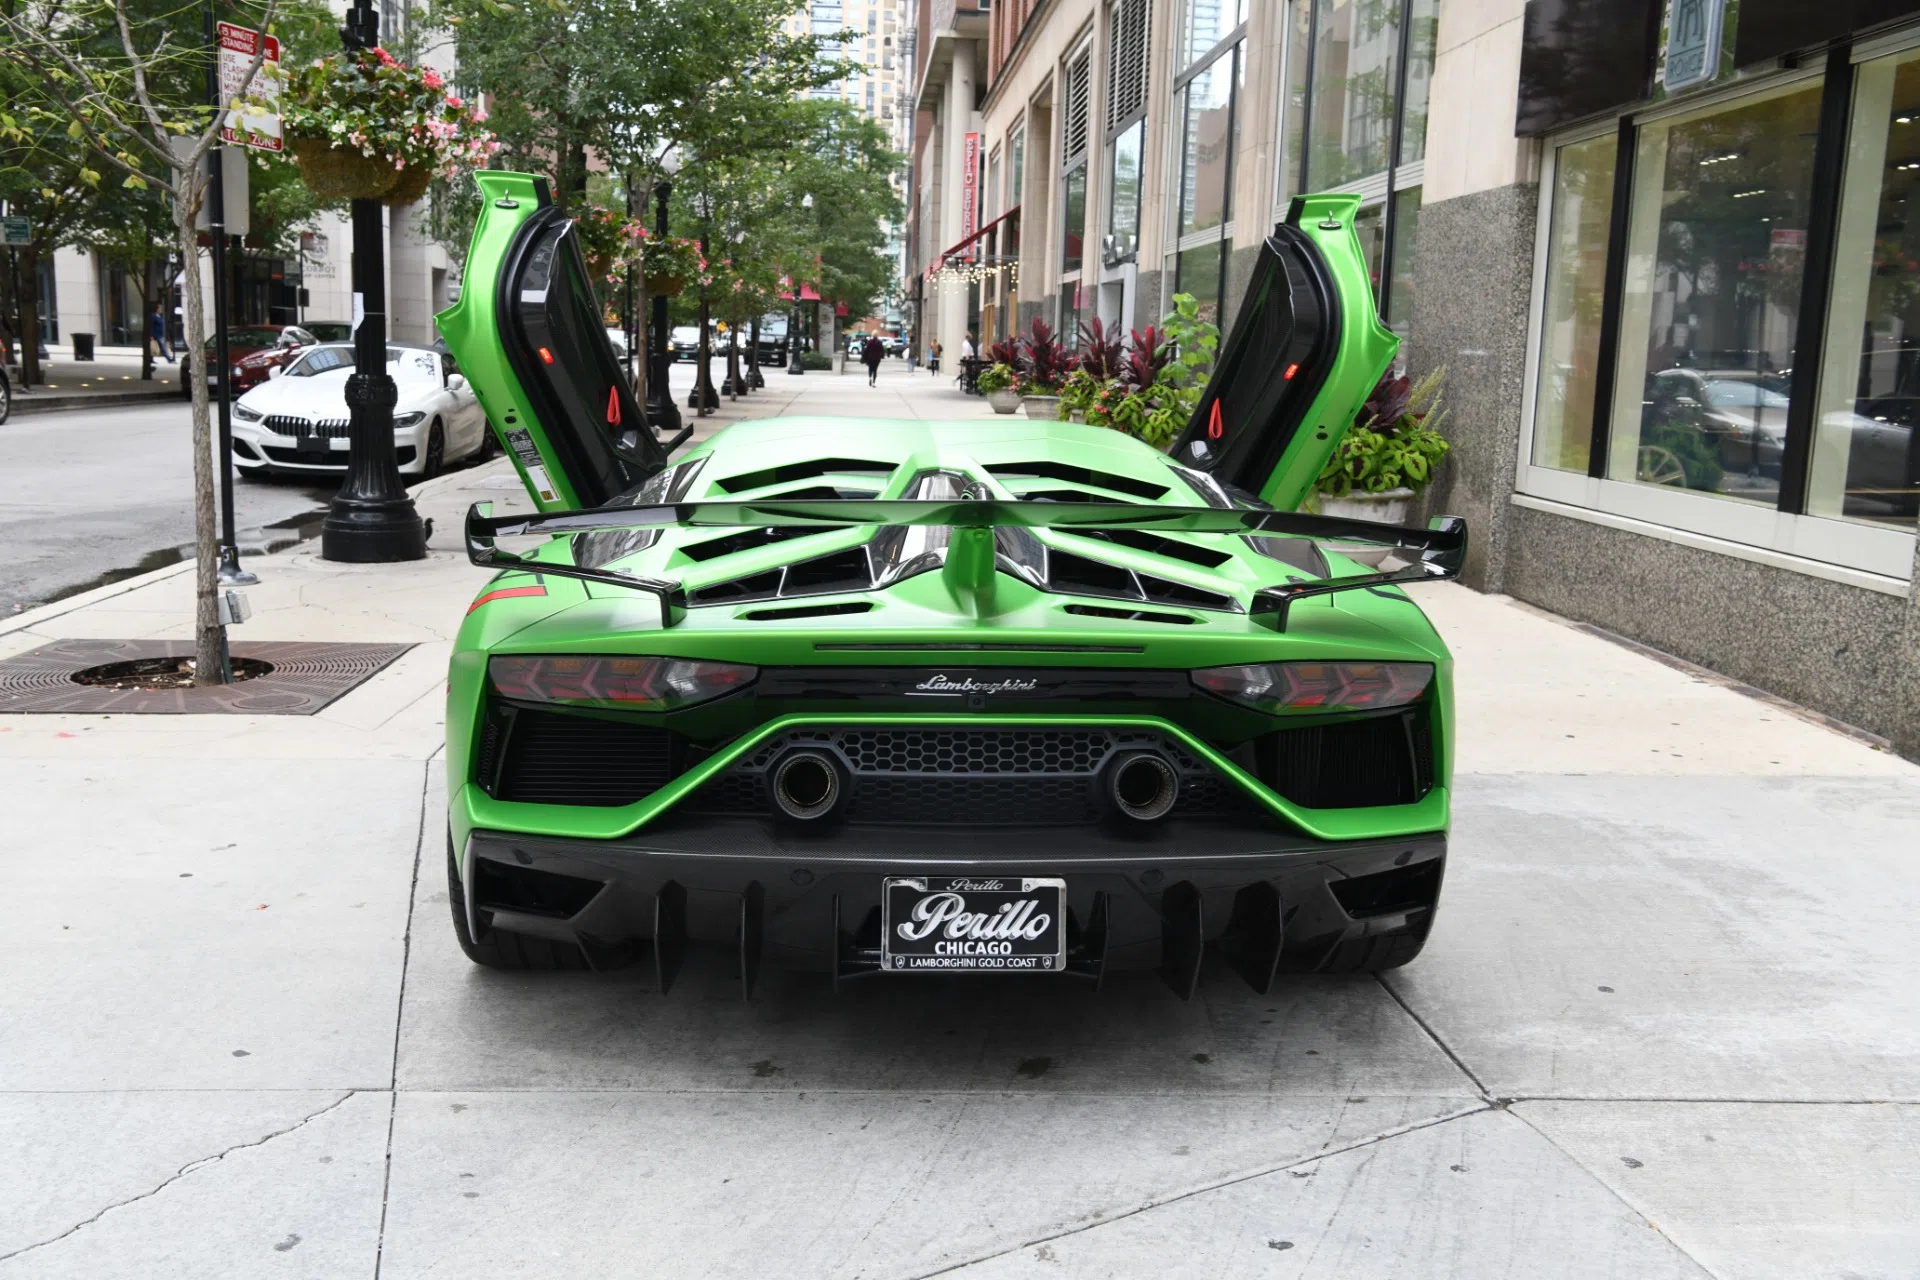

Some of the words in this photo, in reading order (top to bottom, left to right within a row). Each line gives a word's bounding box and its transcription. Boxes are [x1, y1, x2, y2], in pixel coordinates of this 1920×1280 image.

[230, 28, 254, 44] MINUTE
[222, 37, 254, 53] STANDING
[223, 53, 236, 63] USE
[251, 133, 277, 149] ZONE
[965, 138, 973, 185] EPIC
[915, 674, 1038, 694] Lamborghini
[946, 878, 1004, 891] Perillo
[897, 892, 1050, 940] Perillo
[934, 941, 1012, 955] CHICAGO
[910, 958, 976, 968] LAMBORGHINI
[978, 957, 1005, 968] GOLD
[1007, 957, 1038, 968] COAST
